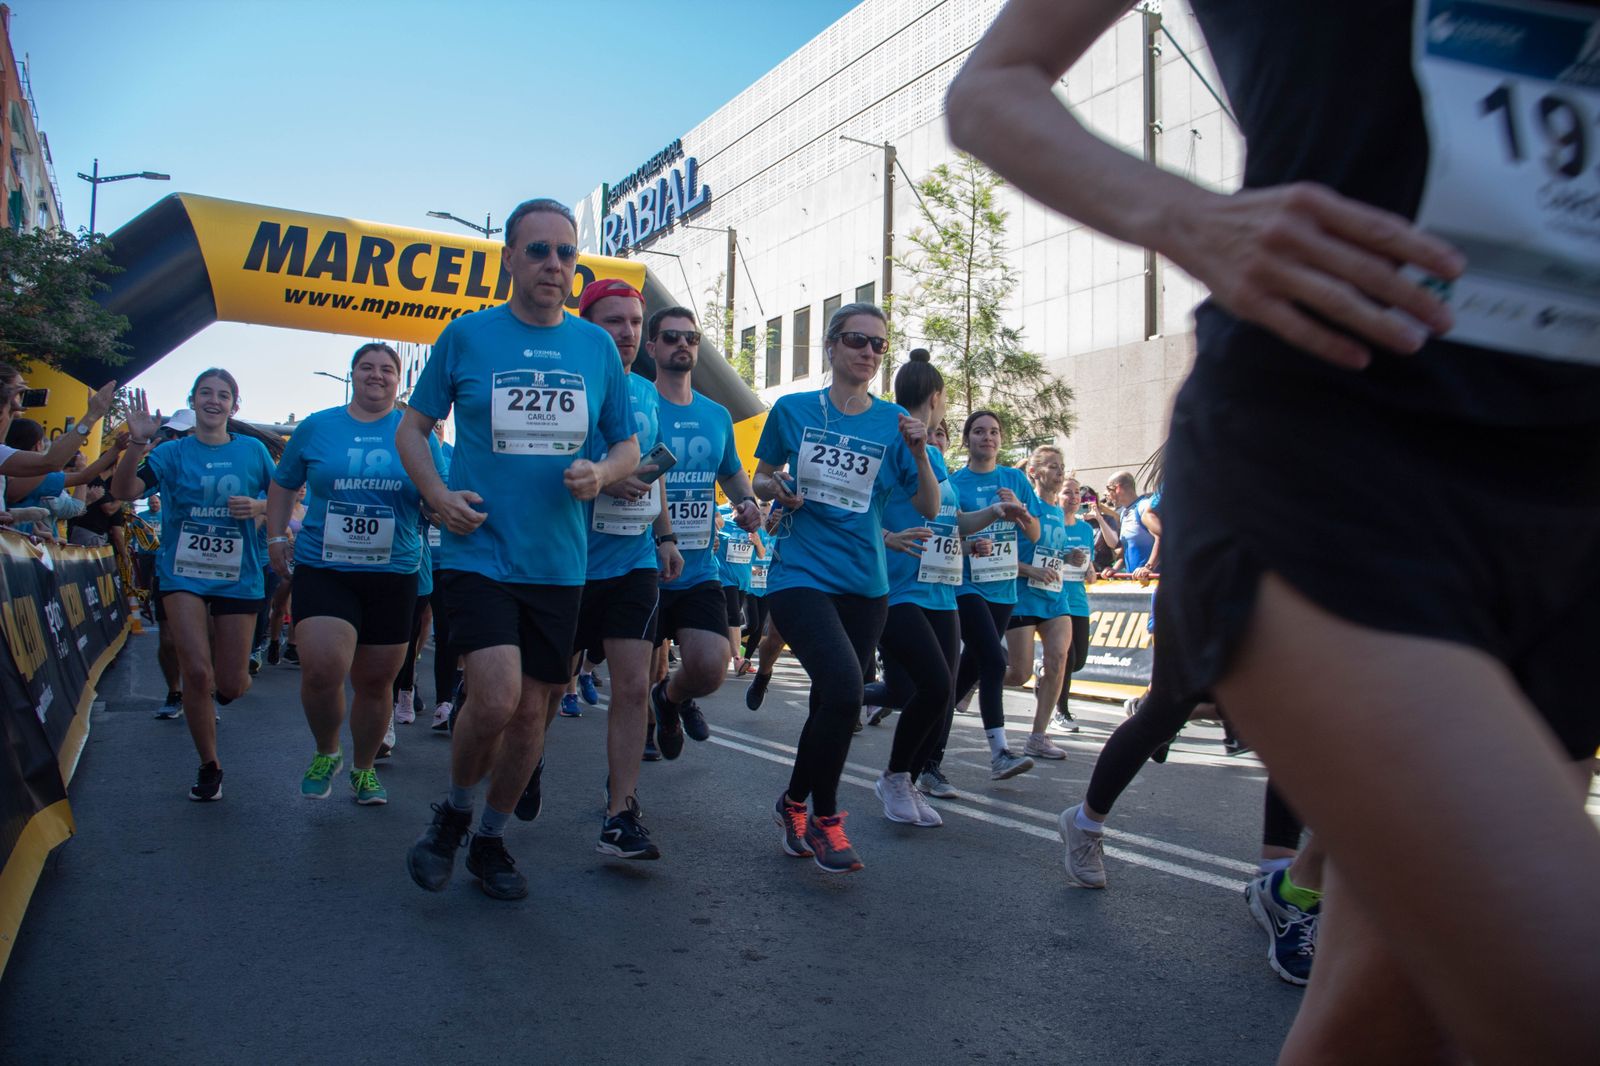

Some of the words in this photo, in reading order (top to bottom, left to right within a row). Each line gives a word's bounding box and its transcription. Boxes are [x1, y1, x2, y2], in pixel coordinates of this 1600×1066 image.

[1477, 80, 1600, 178] 19
[243, 221, 596, 309] MARCELIO
[507, 389, 575, 413] 2276
[527, 413, 556, 421] CARLOS
[810, 445, 870, 475] 2333
[827, 468, 848, 478] CLARA
[334, 478, 403, 492] MARCELINO
[668, 503, 707, 519] 1502
[342, 517, 379, 535] 380
[188, 535, 234, 554] 2033
[732, 544, 751, 552] 1107
